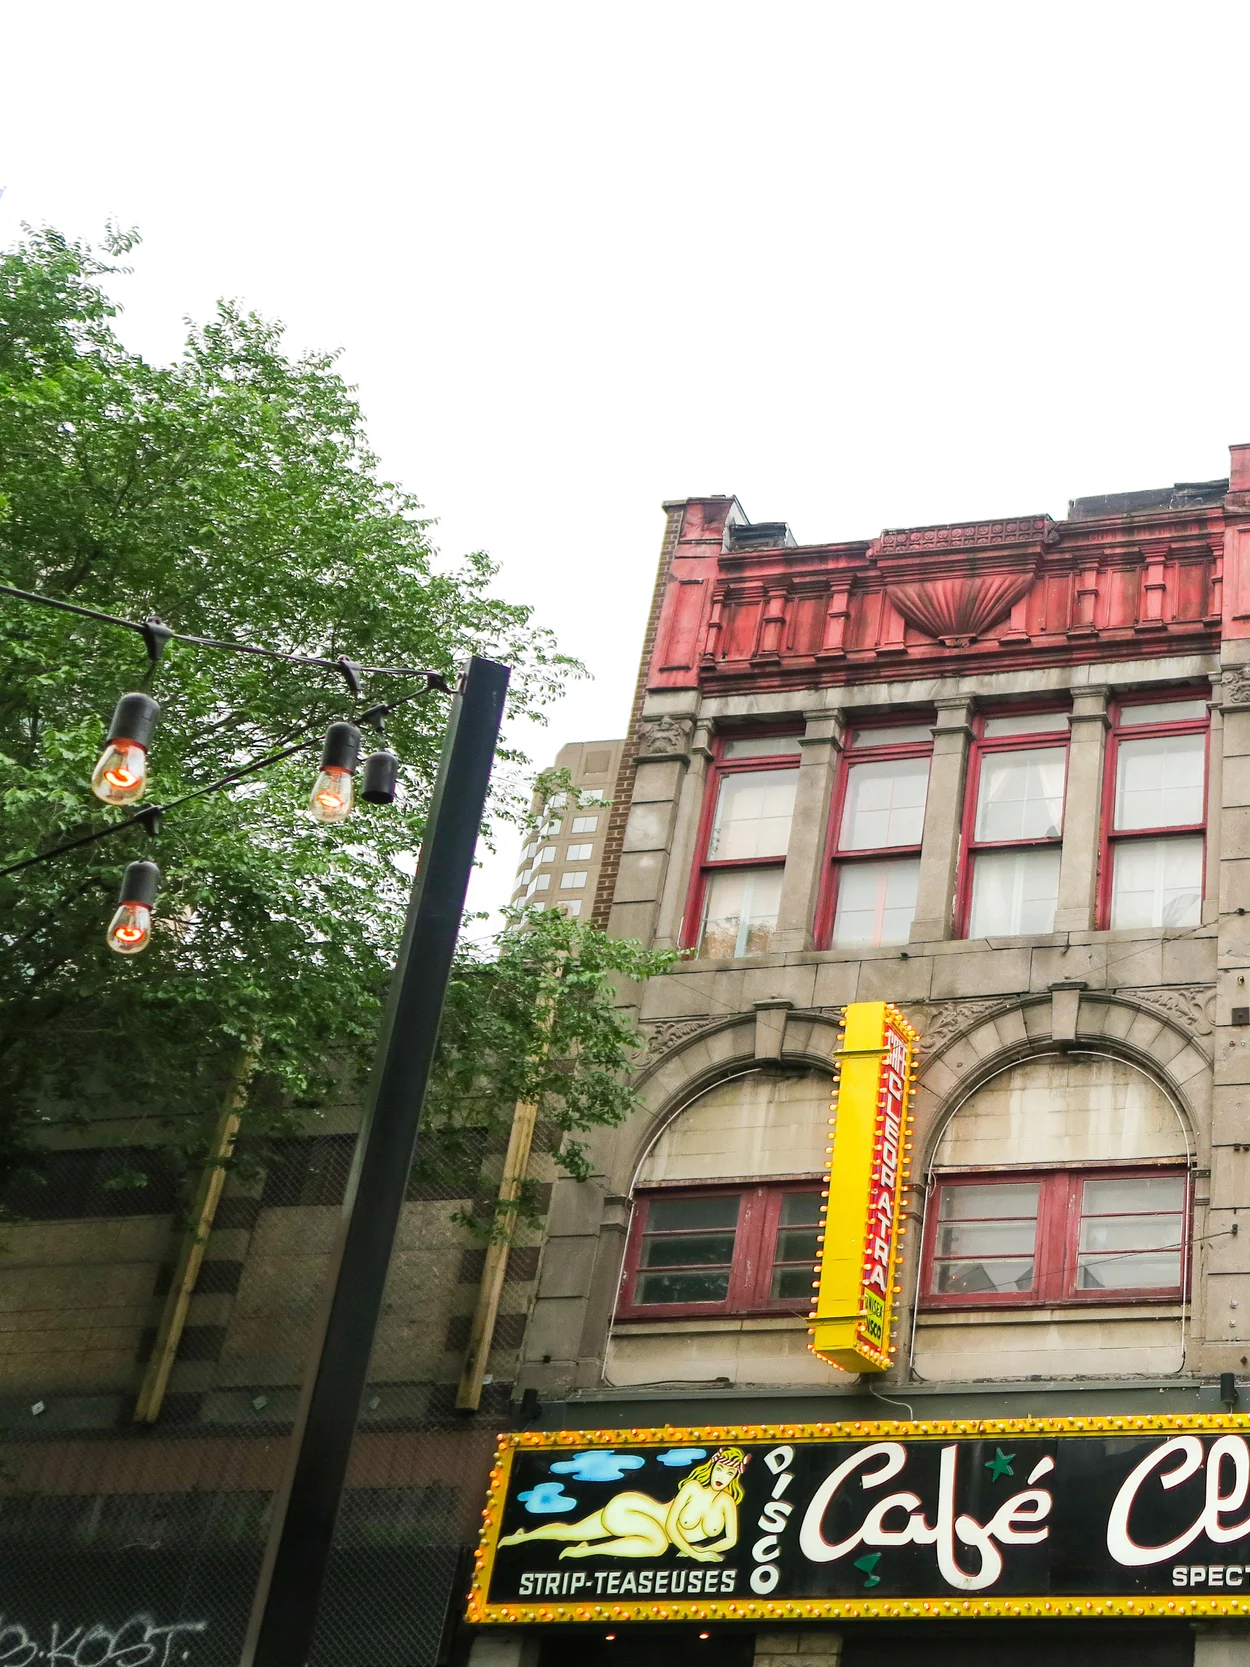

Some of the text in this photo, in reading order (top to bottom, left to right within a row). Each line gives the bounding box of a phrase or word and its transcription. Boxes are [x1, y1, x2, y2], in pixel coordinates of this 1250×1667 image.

[870, 1071, 904, 1294] CLEOPATRA
[518, 1569, 737, 1596] STRIP-TEASEUSES
[749, 1445, 795, 1596] DISCO
[799, 1441, 1055, 1591] Café
